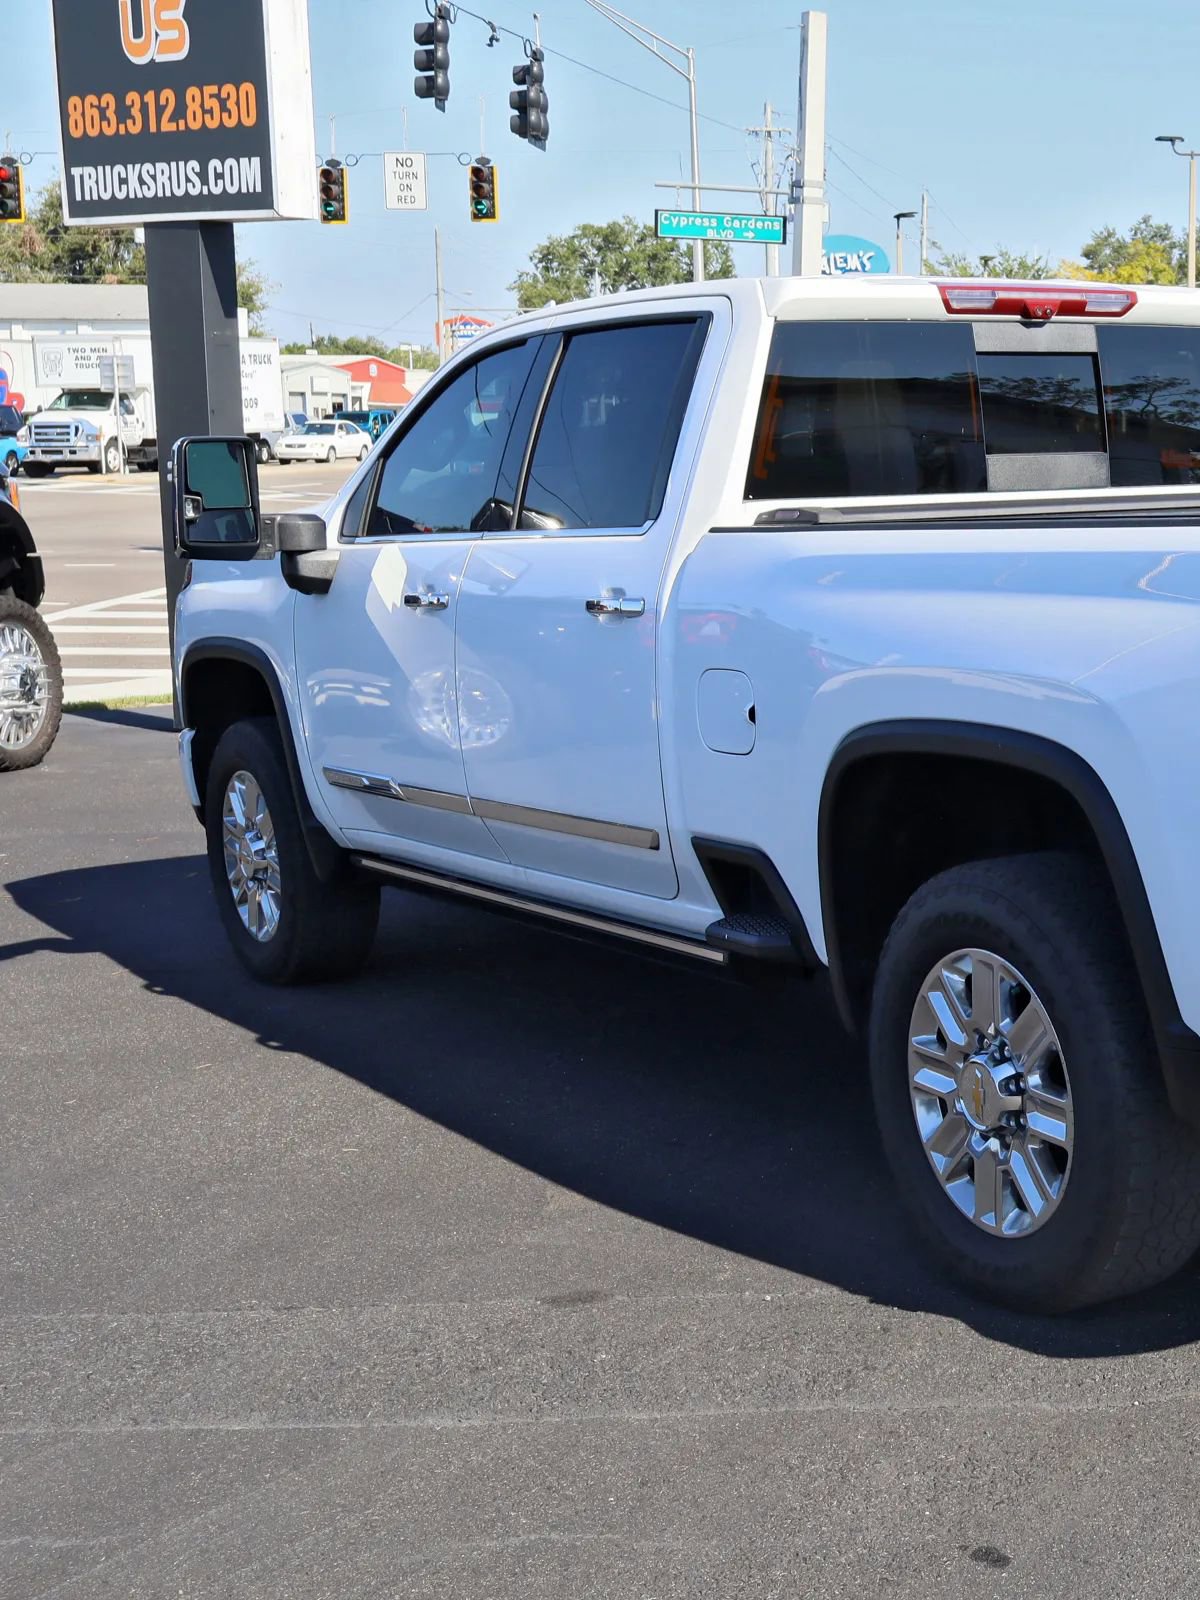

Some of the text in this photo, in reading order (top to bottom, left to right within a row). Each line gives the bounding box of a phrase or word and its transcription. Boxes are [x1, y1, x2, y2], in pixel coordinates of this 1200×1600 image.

[118, 0, 190, 65] US
[67, 82, 257, 138] 863.312.8530
[395, 156, 414, 168] NO
[70, 156, 262, 201] TRUCKSRUS.COM
[392, 170, 418, 180] TURN
[399, 182, 413, 192] ON
[397, 194, 416, 204] RED
[661, 214, 781, 231] Cypress Gardens
[706, 229, 734, 239] BLVD
[820, 250, 876, 276] ALEM'S
[241, 353, 272, 366] A TRUCK
